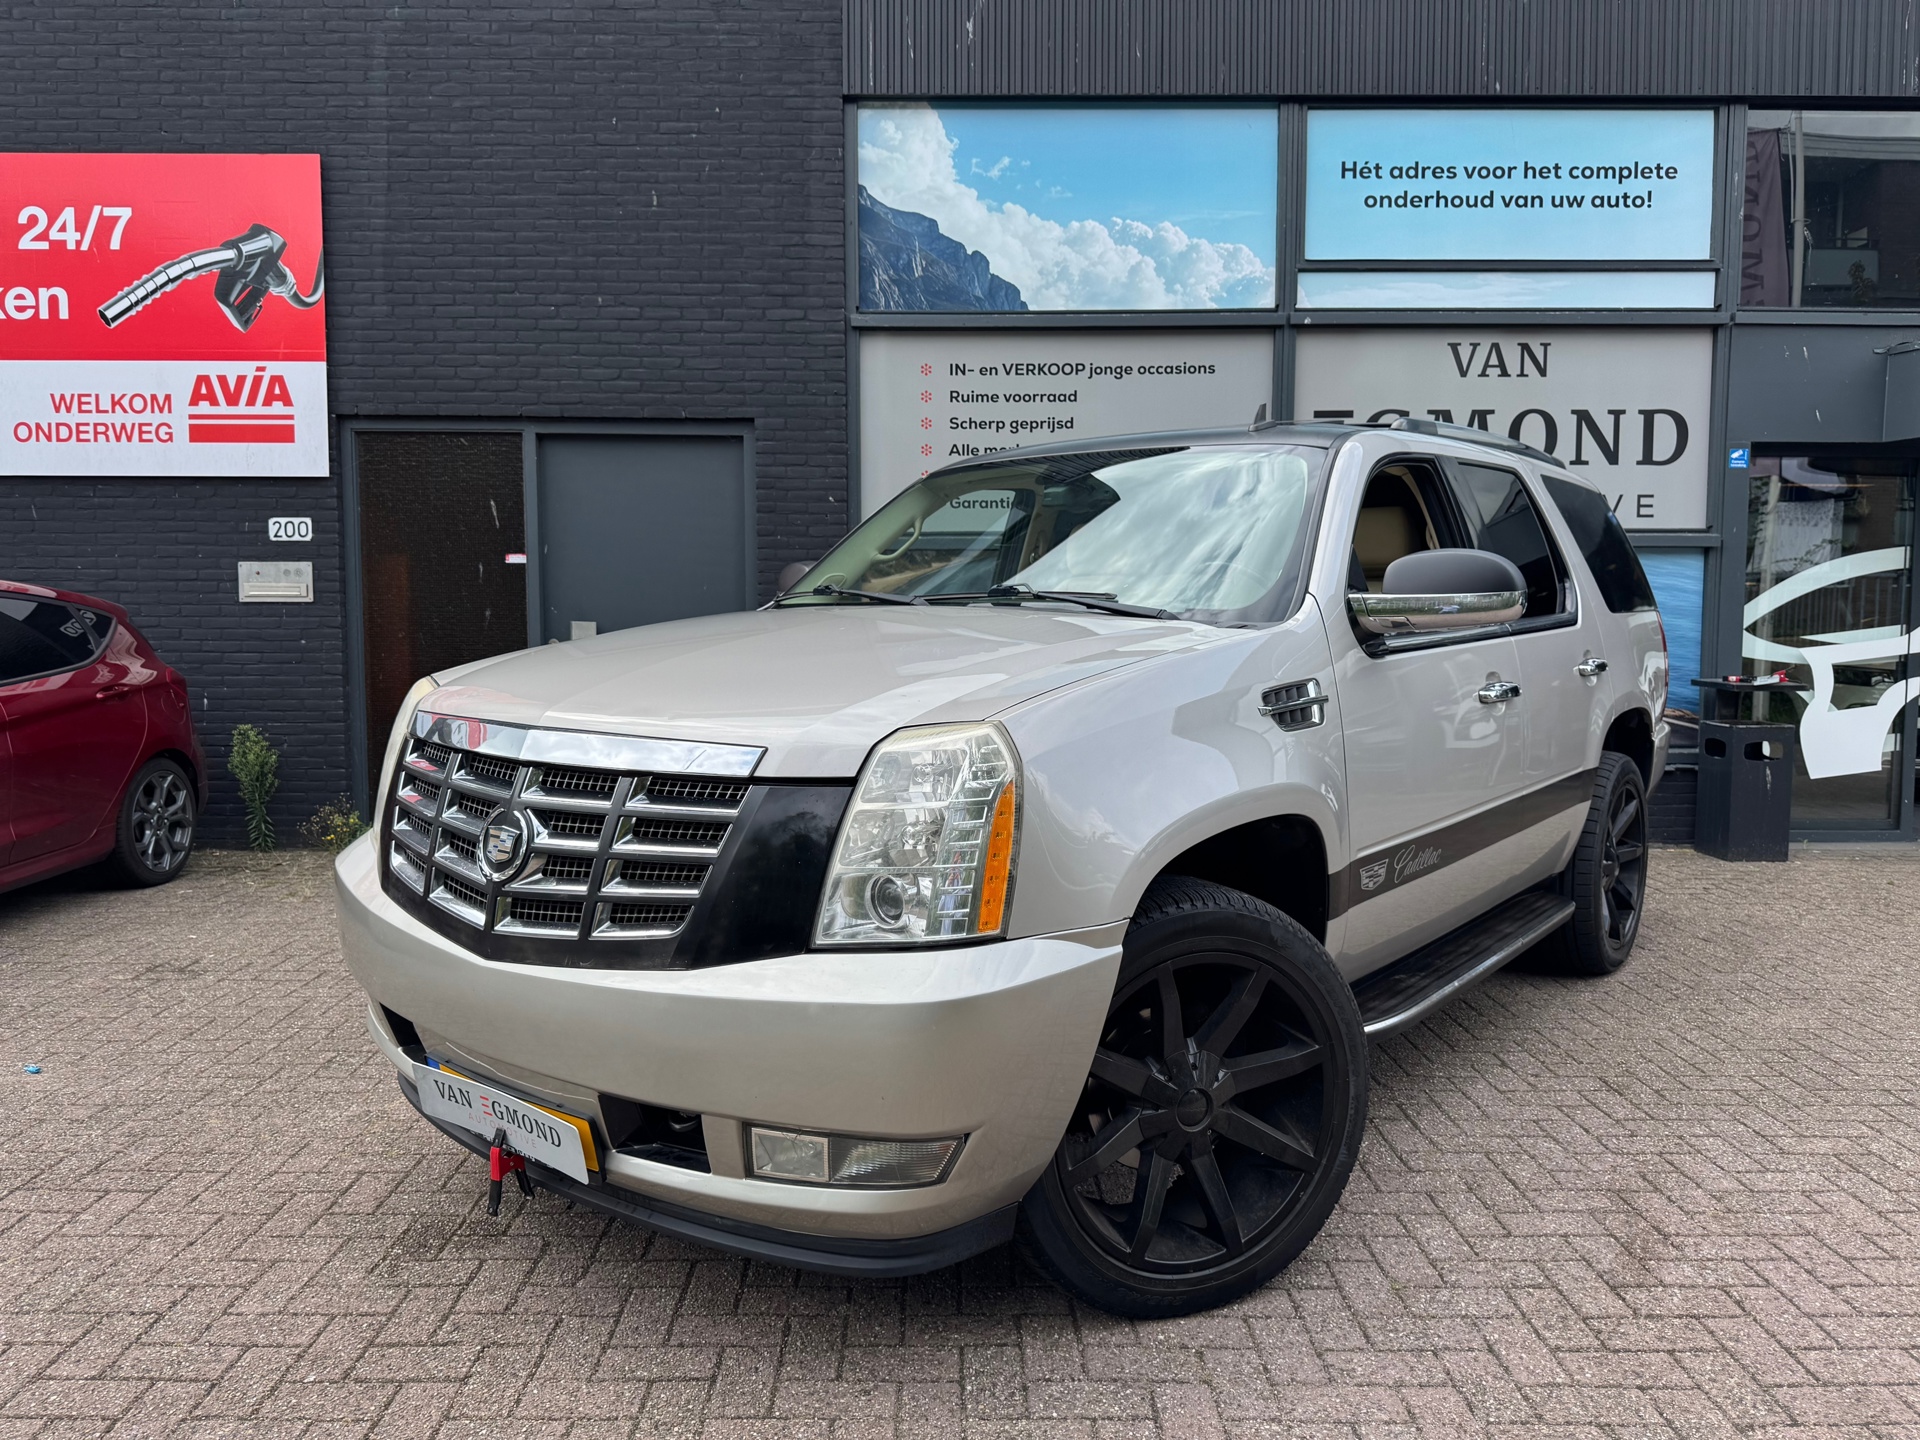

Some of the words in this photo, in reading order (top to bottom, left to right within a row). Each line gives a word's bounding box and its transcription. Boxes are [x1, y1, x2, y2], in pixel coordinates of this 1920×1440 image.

[1340, 161, 1383, 179] Hét
[1389, 161, 1458, 180] adres
[1463, 165, 1518, 180] voor
[1523, 161, 1562, 180] het
[1568, 161, 1678, 185] complete
[1363, 190, 1495, 209] onderhoud
[1501, 194, 1544, 209] van
[1550, 194, 1585, 209] uw
[1590, 190, 1653, 209] auto!
[17, 205, 132, 251] 24/7
[0, 286, 69, 320] en
[1447, 342, 1552, 378] VAN
[949, 363, 975, 376] IN-
[979, 365, 999, 376] en
[1002, 363, 1086, 376] VERKOOP
[1087, 363, 1133, 380] jonge
[1137, 362, 1216, 375] occasions
[50, 393, 173, 414] WELKOM
[949, 390, 1000, 403] Ruime
[1003, 390, 1078, 403] voorraad
[12, 422, 174, 443] ONDERWEG
[949, 417, 1005, 433] Scherp
[1010, 417, 1074, 433] geprijsd
[948, 444, 980, 457] Alle
[272, 520, 309, 538] 200
[1393, 844, 1442, 884] Cadillac
[433, 1079, 473, 1109] VAN
[479, 1095, 562, 1148] EGMOND
[468, 1112, 537, 1149] AUTOOTIVE
